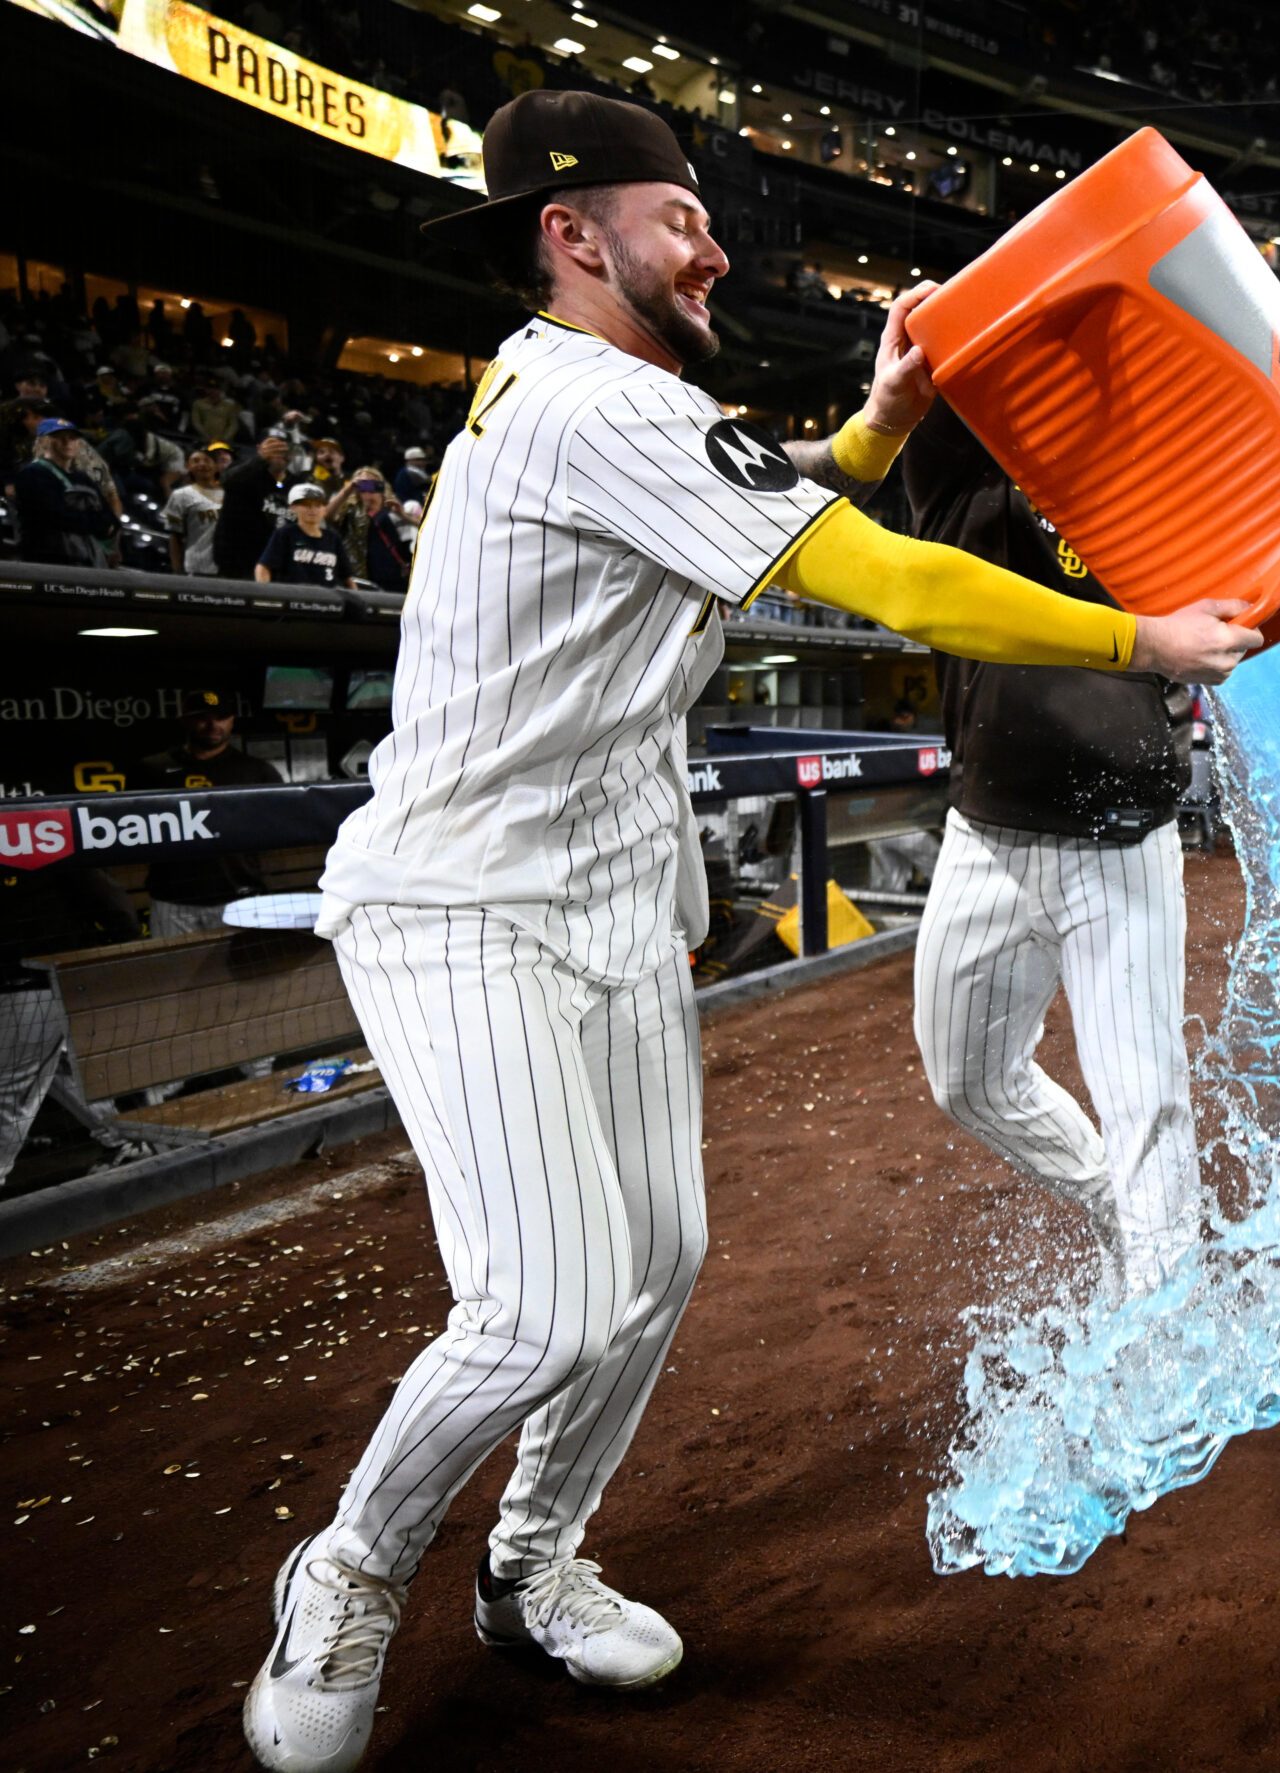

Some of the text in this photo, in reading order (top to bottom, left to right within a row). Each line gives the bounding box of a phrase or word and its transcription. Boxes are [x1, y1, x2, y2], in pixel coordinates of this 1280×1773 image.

[897, 3, 919, 27] 31
[923, 15, 1000, 56] WINFIELD
[207, 26, 367, 139] PADRES
[793, 68, 1083, 168] JERRY COLEMAN
[44, 583, 58, 593] UC
[59, 584, 76, 595] San
[76, 586, 99, 597] Diego
[100, 587, 125, 599] Health
[0, 695, 46, 721] an
[52, 686, 152, 728] Diego
[687, 763, 722, 793] ank
[800, 753, 863, 782] us bank
[919, 747, 952, 772] us ba
[0, 800, 215, 857] us bank
